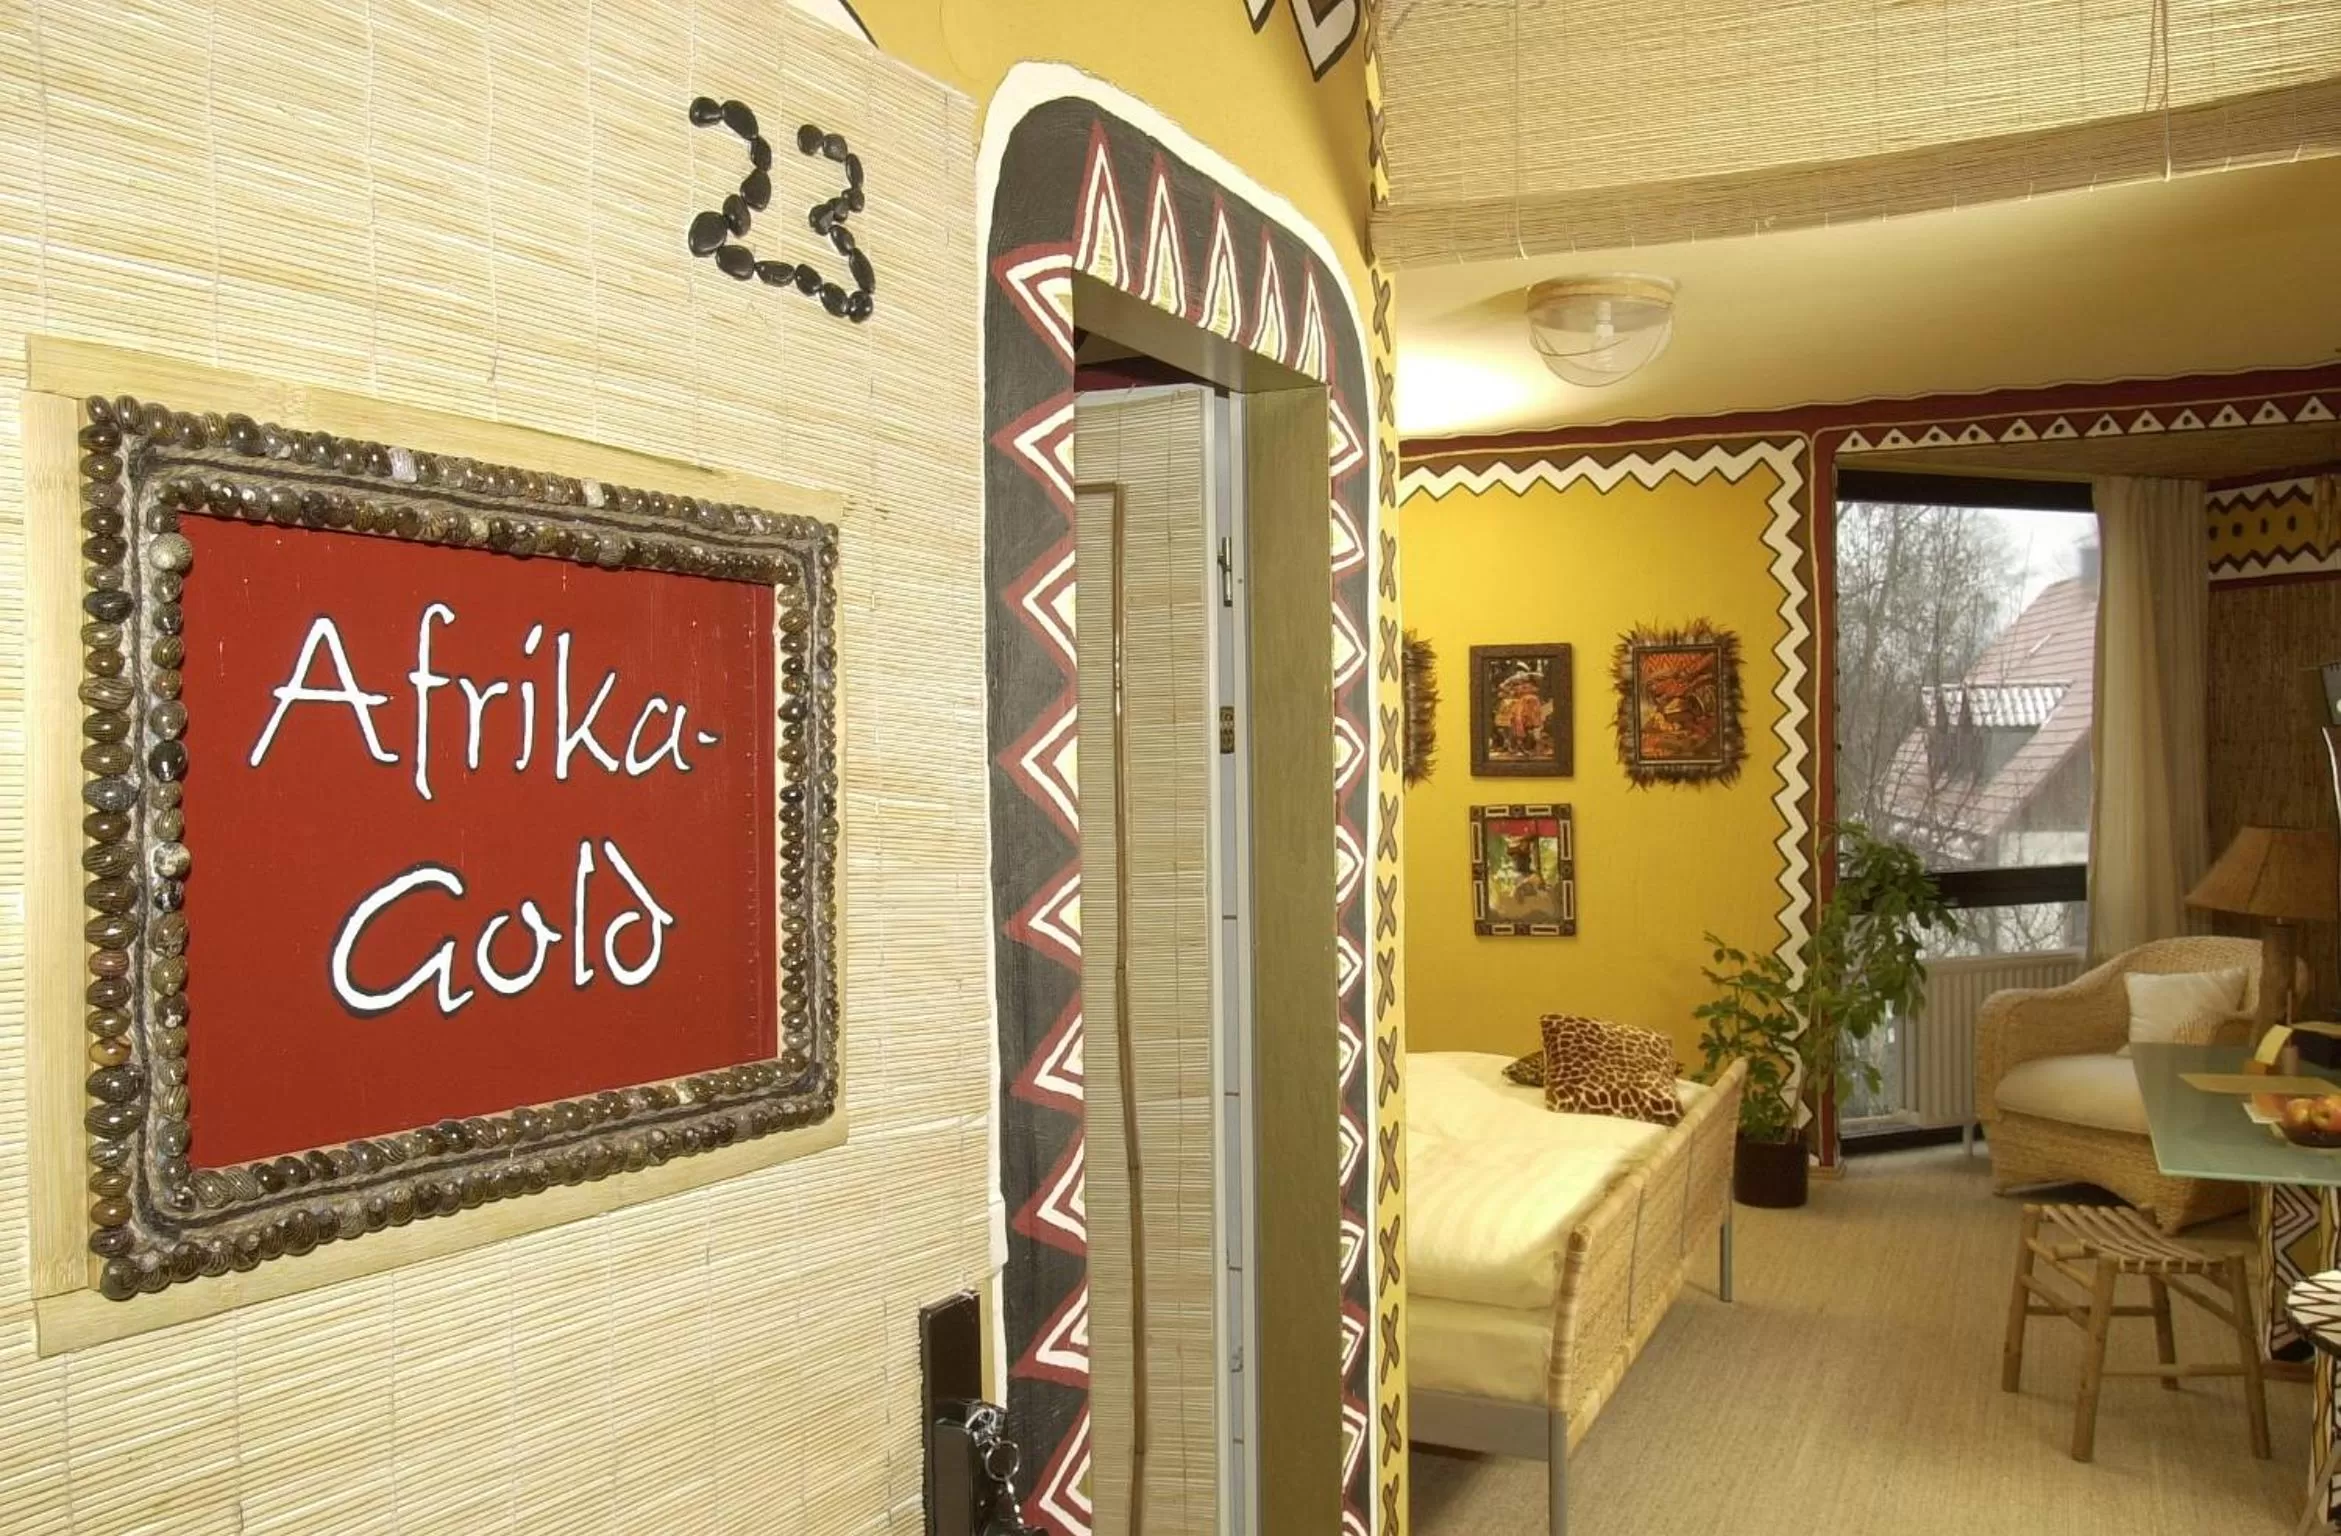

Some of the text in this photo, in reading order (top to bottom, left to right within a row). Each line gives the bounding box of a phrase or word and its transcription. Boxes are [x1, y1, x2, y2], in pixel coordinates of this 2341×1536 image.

[688, 97, 875, 323] 23
[249, 603, 719, 801] Afrika-
[329, 839, 675, 1017] Gold
